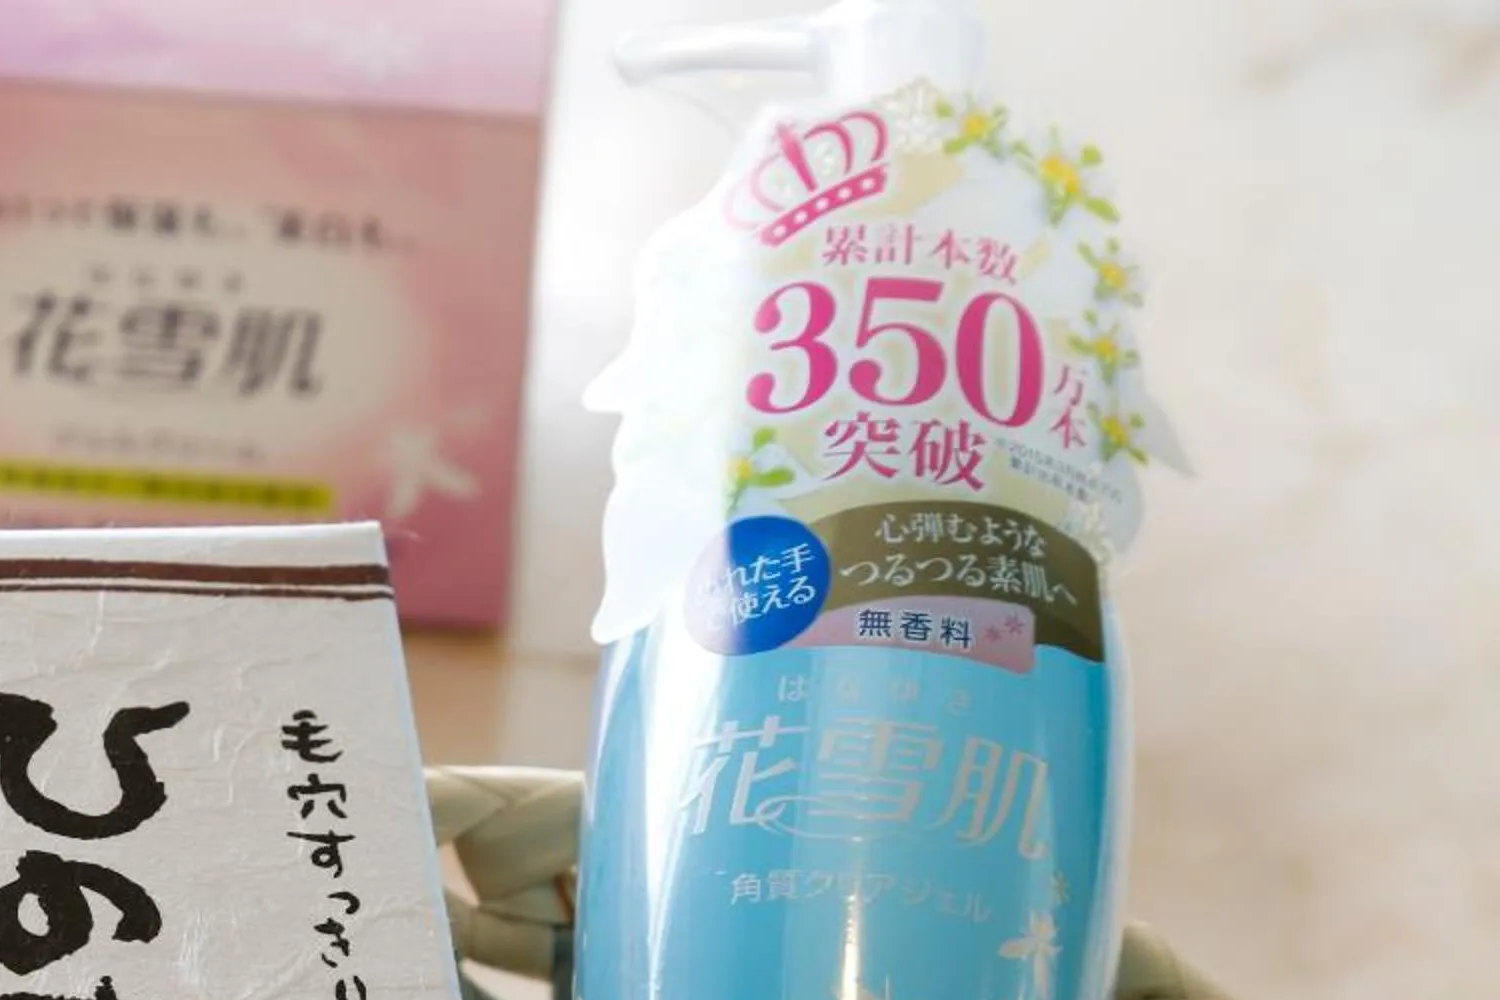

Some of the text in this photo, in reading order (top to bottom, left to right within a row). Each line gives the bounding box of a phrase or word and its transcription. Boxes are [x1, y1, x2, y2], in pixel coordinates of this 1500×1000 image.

[822, 224, 1020, 286] 累計本数
[6, 290, 325, 400] 花雪肌
[746, 278, 1045, 428] 350
[1050, 364, 1090, 452] 万本
[822, 411, 987, 494] 突破
[875, 512, 1047, 558] 心弾むような
[705, 541, 816, 605] れた手
[839, 553, 1080, 606] つるつる素肌へ
[857, 608, 973, 650] 無香料
[680, 715, 1051, 862] 花雪肌
